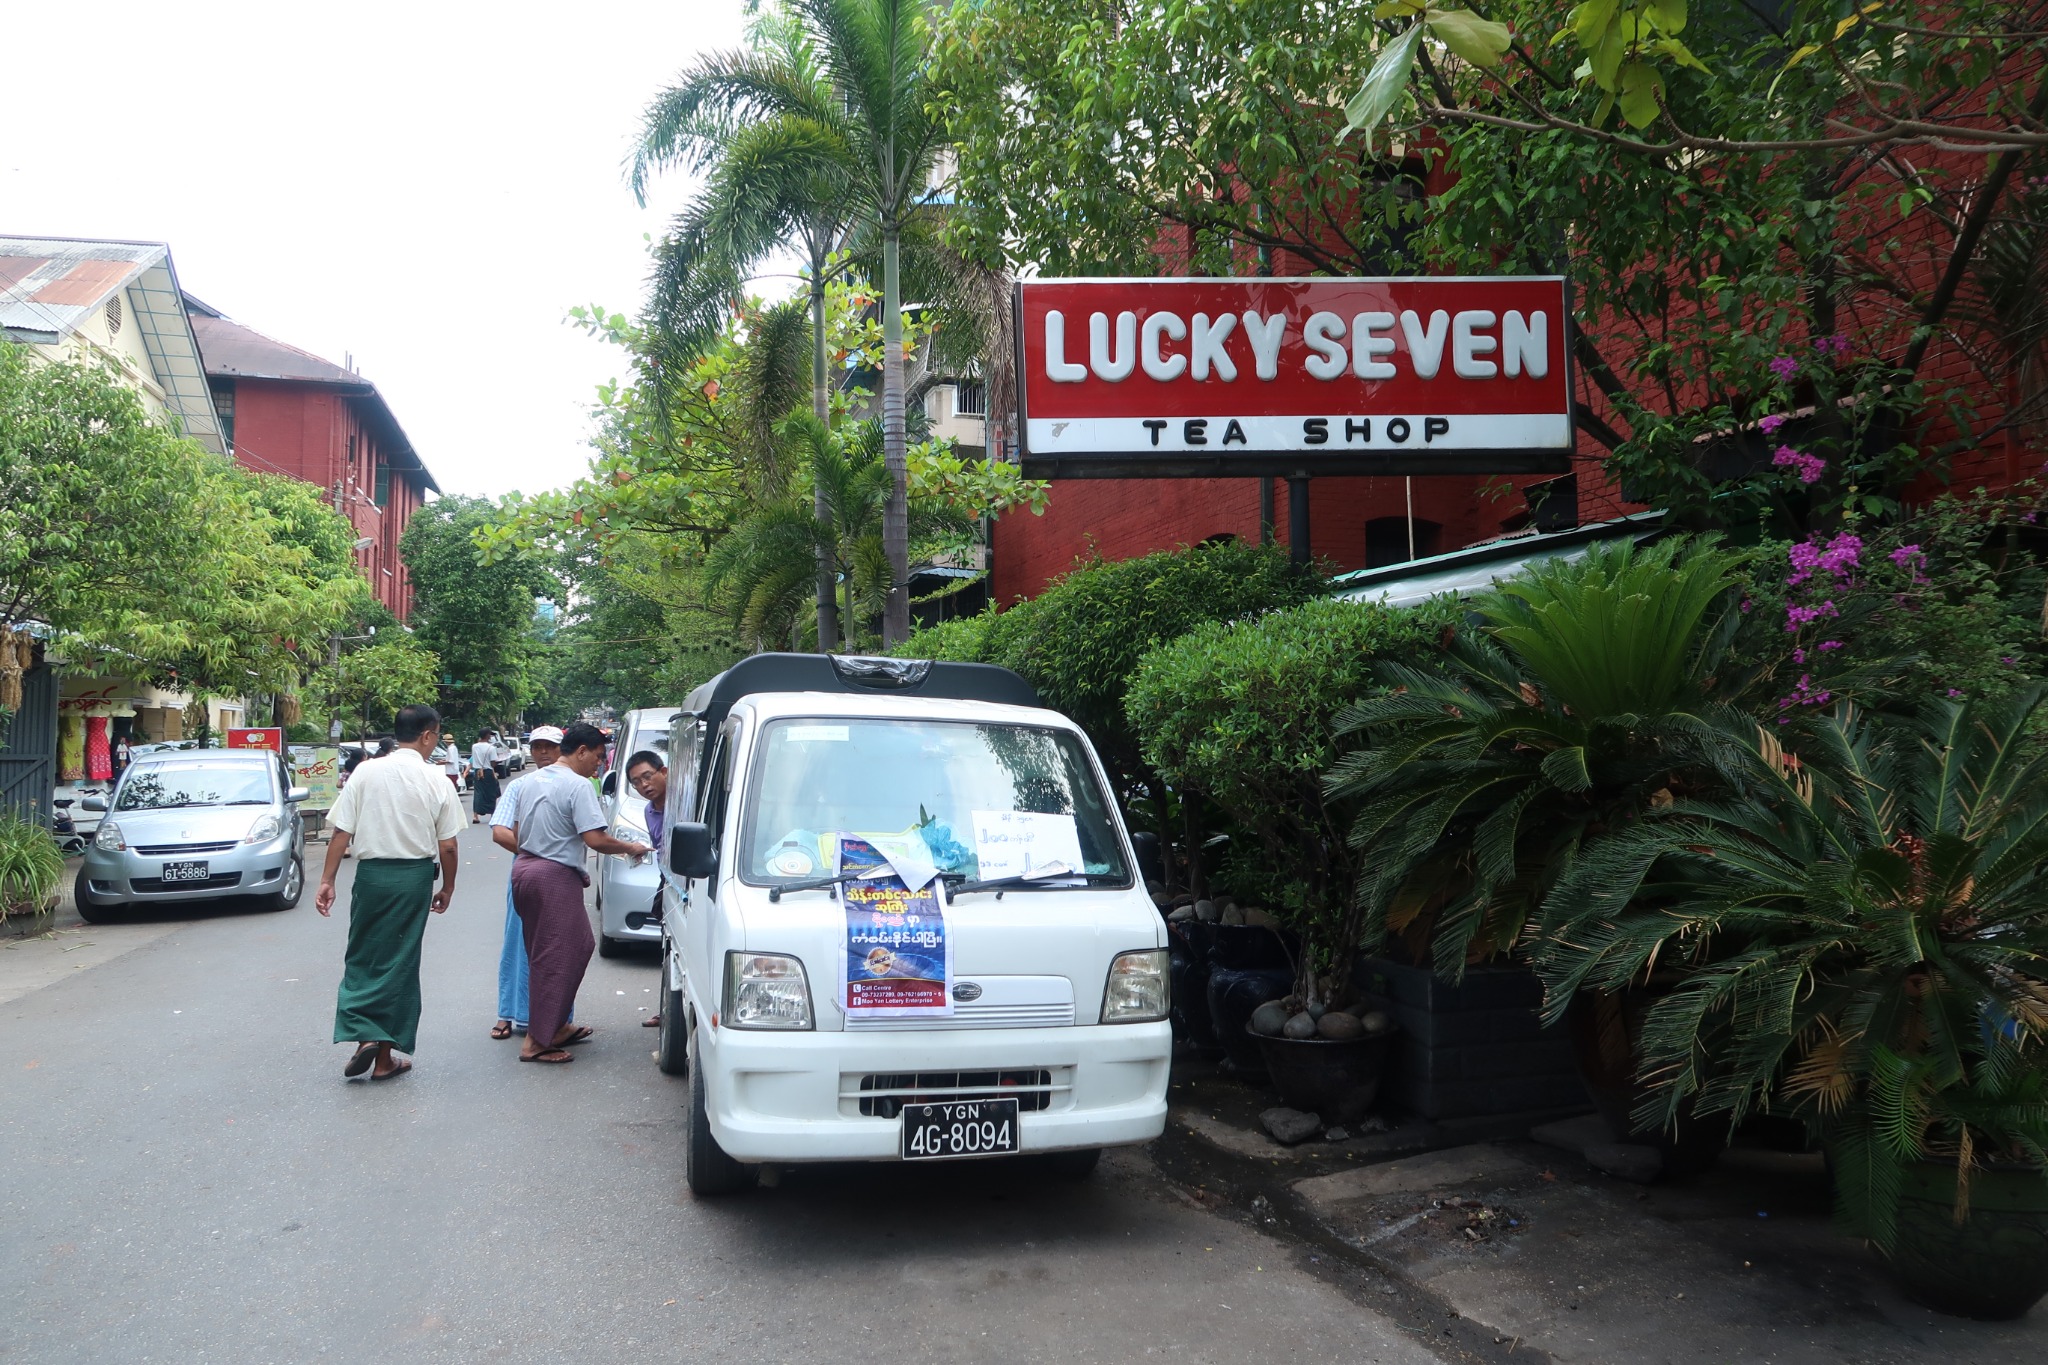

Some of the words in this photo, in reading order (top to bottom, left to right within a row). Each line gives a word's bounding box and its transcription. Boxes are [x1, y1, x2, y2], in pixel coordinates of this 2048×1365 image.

[1045, 309, 1287, 383] LUCKY
[1303, 309, 1548, 380] SEVEN
[1142, 419, 1248, 446] TEA
[1303, 417, 1450, 444] SHOP
[165, 867, 206, 880] 6I-5886
[943, 1104, 979, 1120] YGN
[910, 1119, 1011, 1155] 4G-8094
